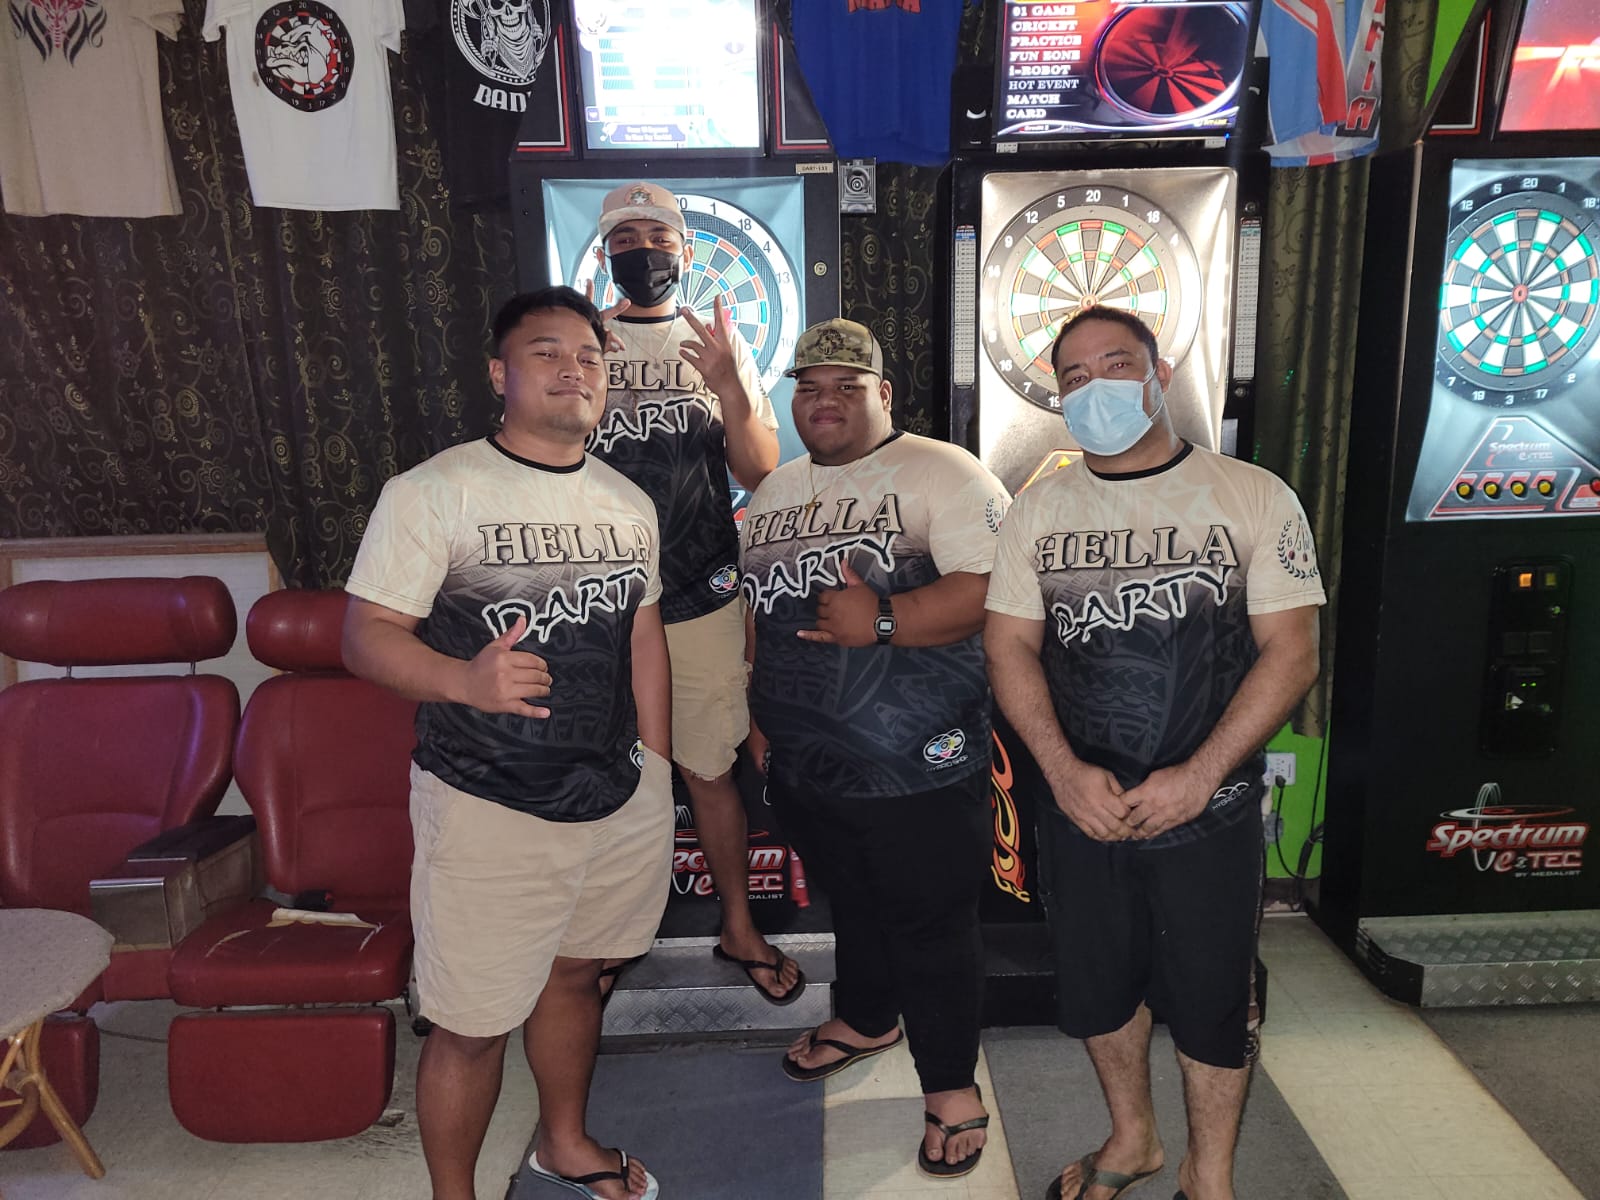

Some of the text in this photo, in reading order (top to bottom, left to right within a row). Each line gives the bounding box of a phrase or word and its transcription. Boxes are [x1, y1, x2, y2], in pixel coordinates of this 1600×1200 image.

[1031, 5, 1076, 16] GAME
[1011, 20, 1079, 32] CRICKET
[1010, 35, 1082, 47] PRACTICE
[1009, 50, 1080, 62] FUN ZONE
[1008, 79, 1080, 90] HOT EVENT
[473, 84, 532, 113] BAN
[1006, 94, 1061, 105] MATCH
[1006, 109, 1047, 119] CARD
[1522, 178, 1539, 188] 20
[1559, 182, 1566, 193] 1
[1057, 196, 1065, 208] 5
[1086, 190, 1101, 203] 20
[1122, 195, 1129, 207] 1
[711, 202, 717, 215] 1
[1461, 200, 1474, 211] 12
[1583, 197, 1597, 209] 18
[1025, 211, 1039, 224] 12
[1146, 210, 1160, 224] 18
[738, 218, 752, 232] 18
[763, 240, 771, 253] 4
[1004, 236, 1013, 248] 9
[776, 272, 790, 284] 13
[781, 336, 794, 349] 10
[1448, 376, 1456, 387] 7
[1567, 373, 1577, 384] 2
[1023, 381, 1032, 394] 7
[1505, 395, 1515, 405] 3
[1535, 389, 1549, 399] 17
[746, 493, 904, 552] HELLA
[478, 523, 650, 566] HELLA
[1035, 525, 1240, 573] HELLA
[1051, 566, 1233, 646] DARTY
[1427, 821, 1588, 856] Spectrum
